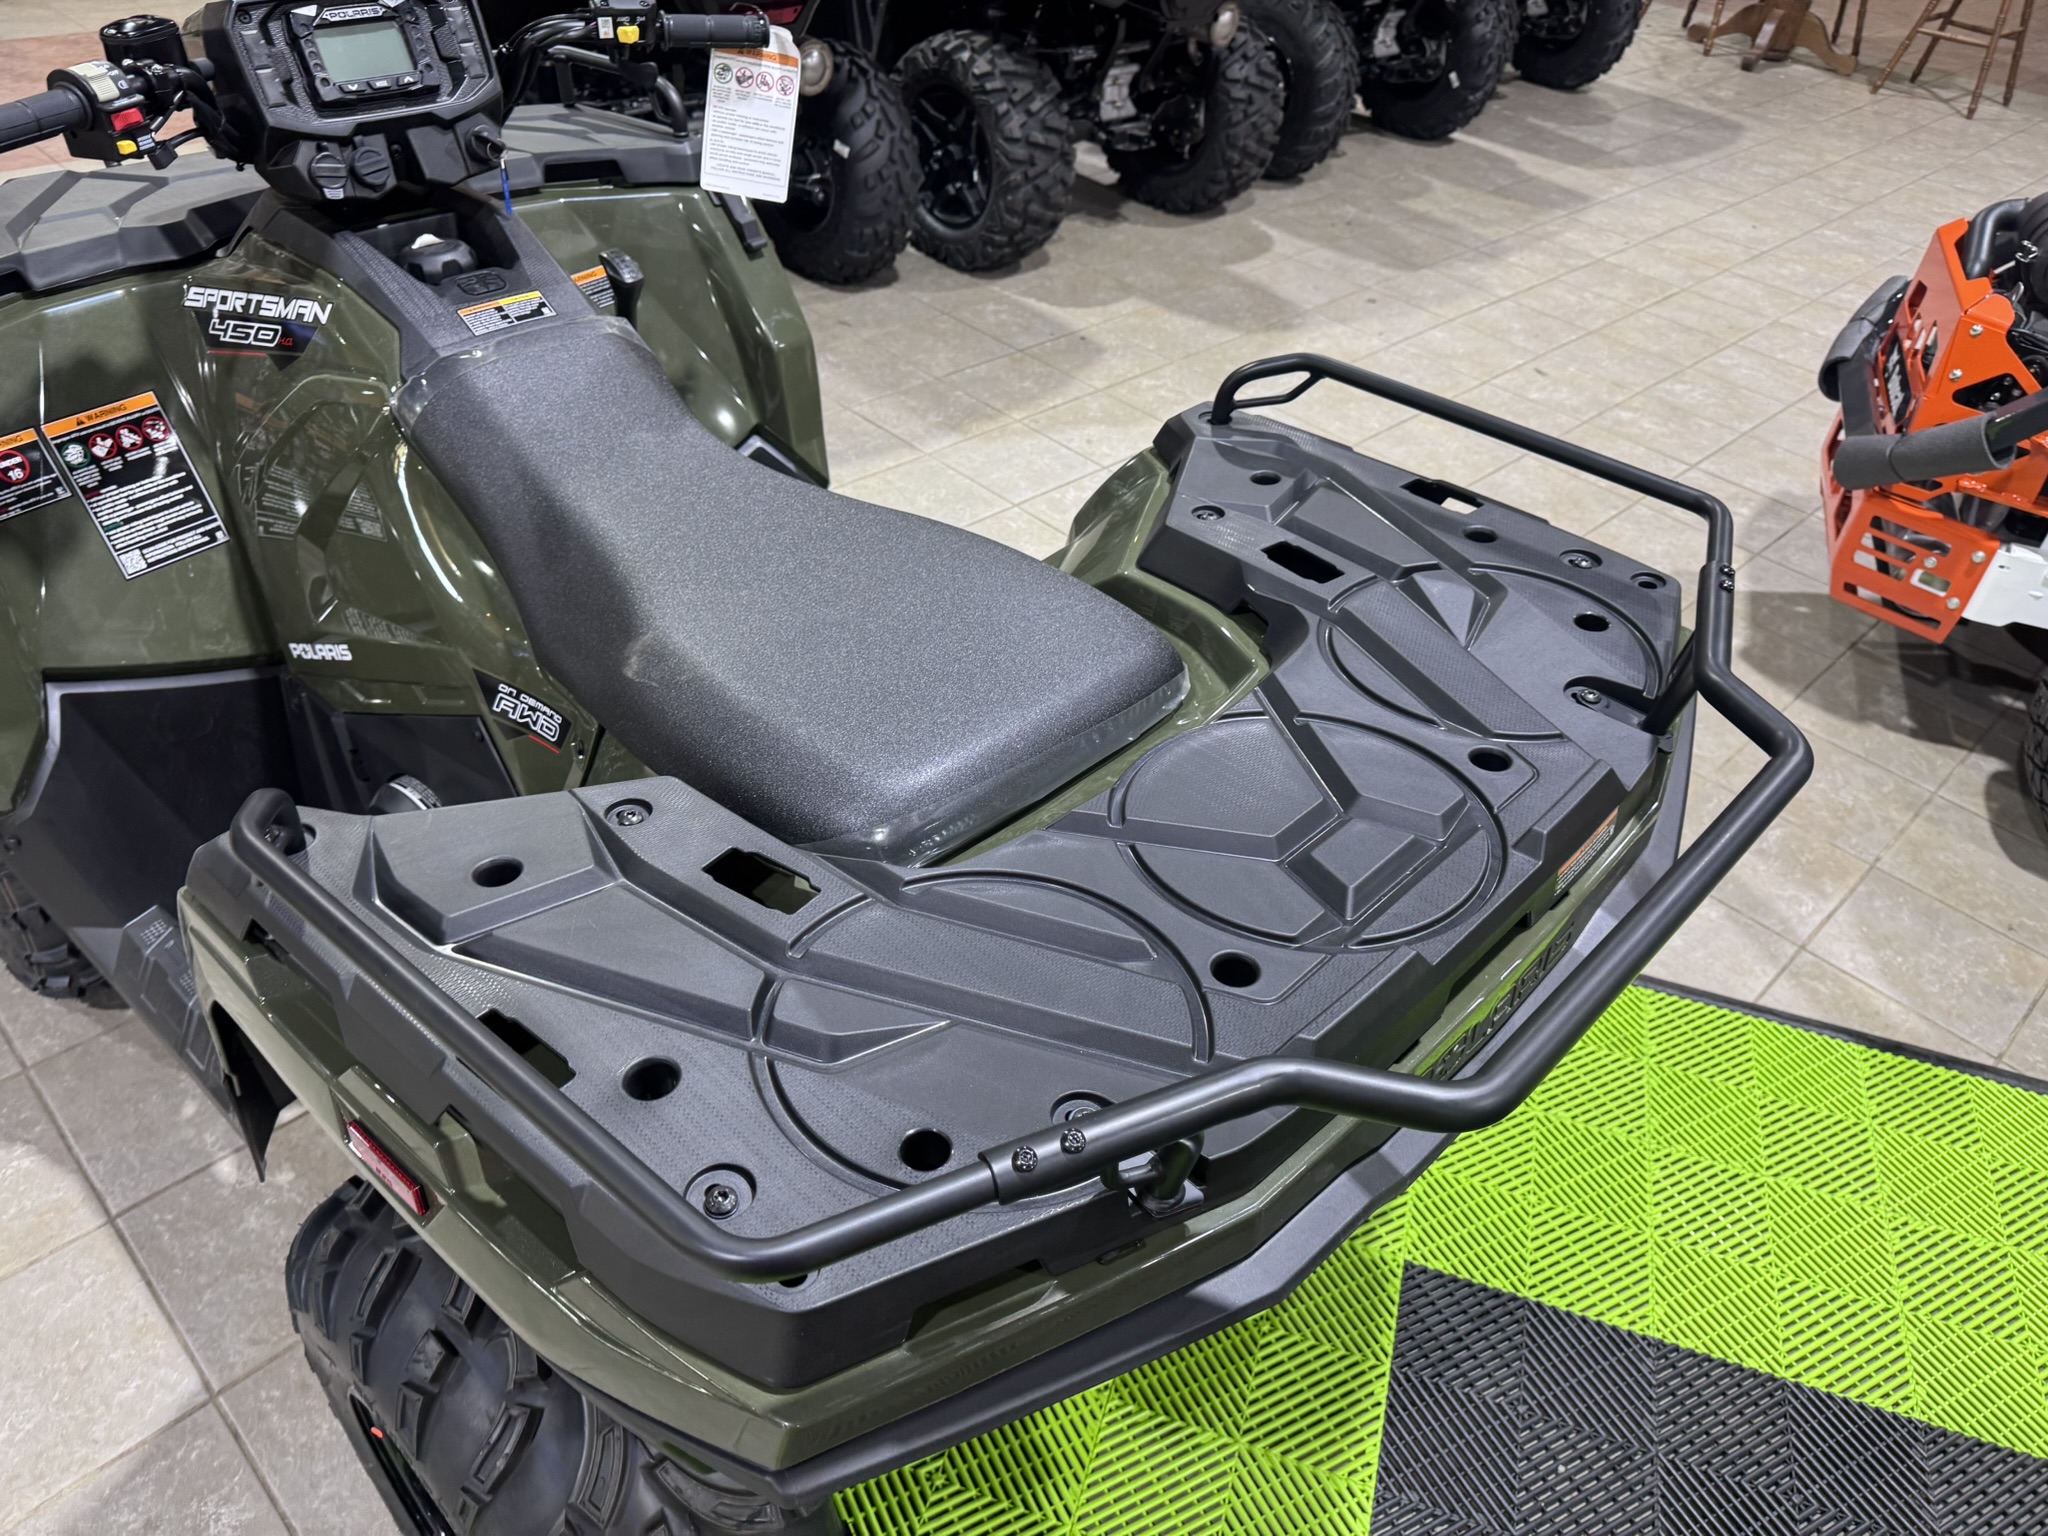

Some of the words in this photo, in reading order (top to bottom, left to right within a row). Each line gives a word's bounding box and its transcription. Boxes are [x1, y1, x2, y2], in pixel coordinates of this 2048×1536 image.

[328, 7, 381, 19] POLARIS
[183, 286, 333, 325] SPORTSMAN
[208, 318, 282, 348] 450
[84, 403, 128, 421] WARNING
[7, 468, 24, 481] 16
[288, 642, 353, 661] POLARIS
[492, 692, 560, 742] AWD
